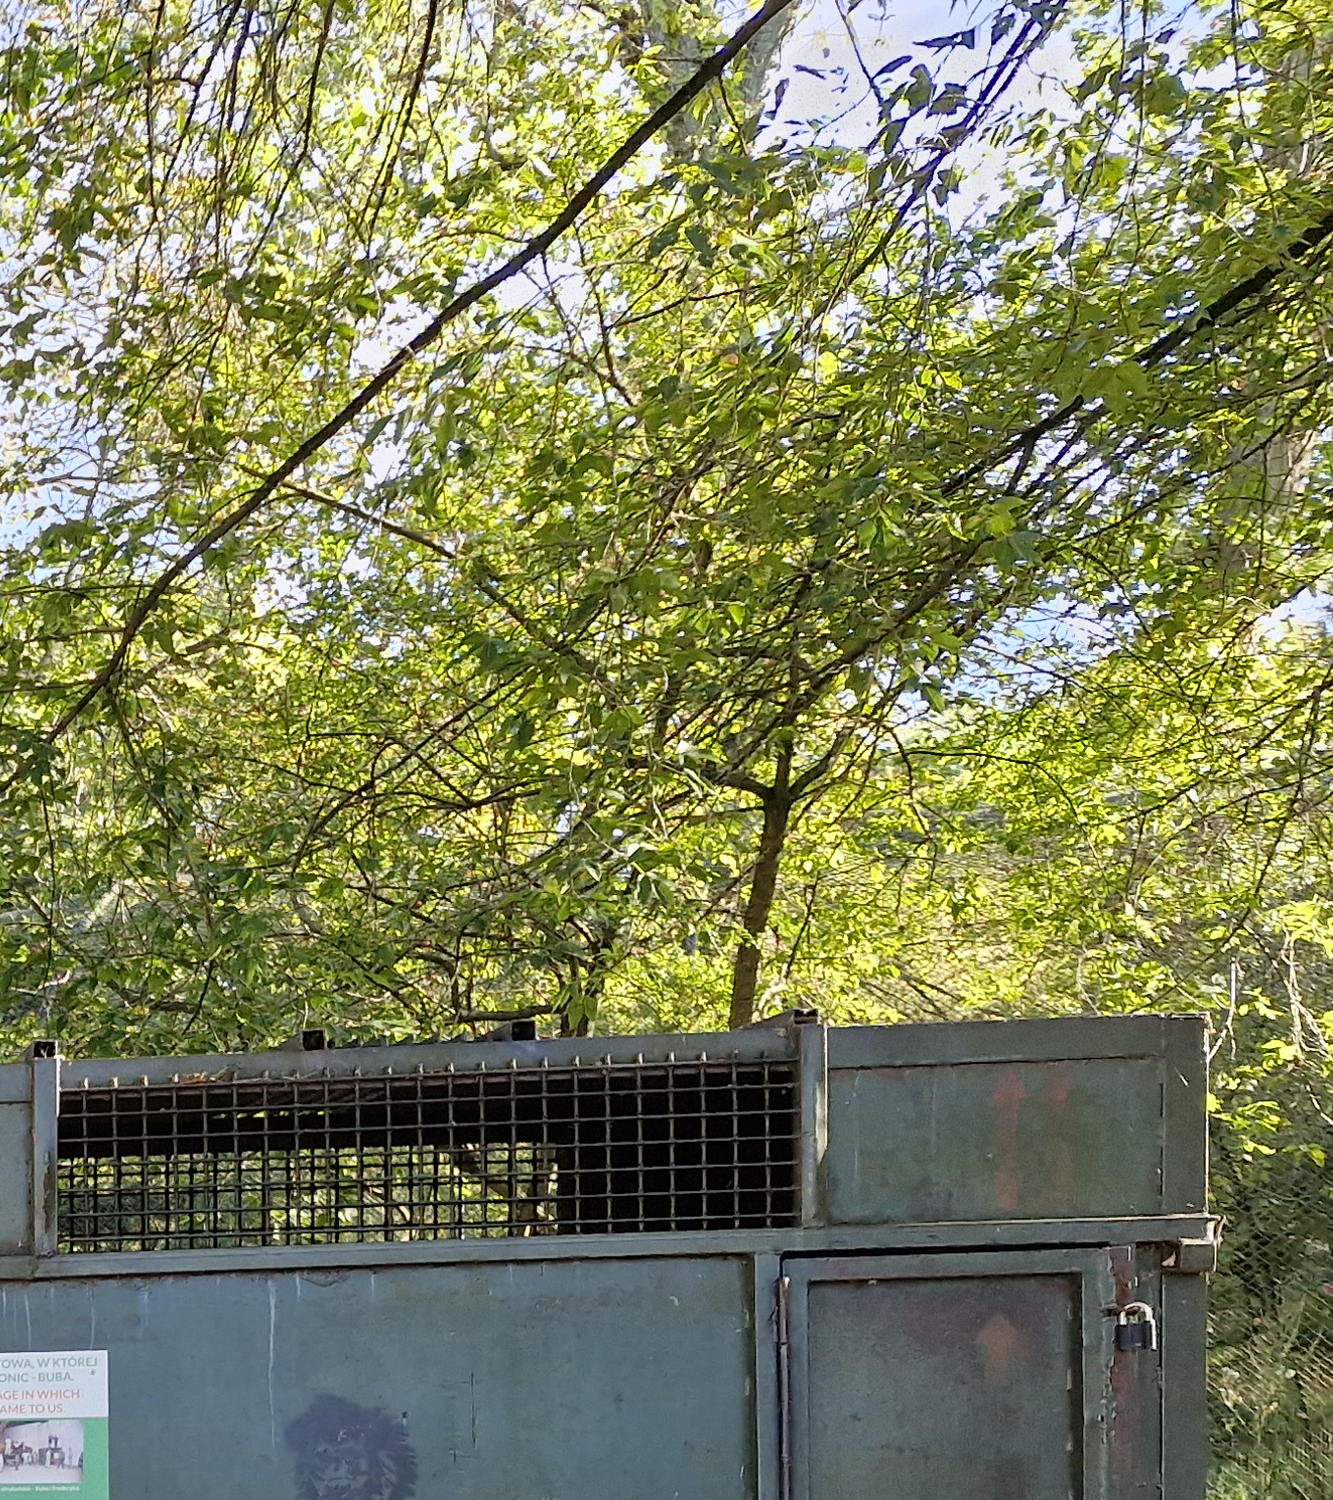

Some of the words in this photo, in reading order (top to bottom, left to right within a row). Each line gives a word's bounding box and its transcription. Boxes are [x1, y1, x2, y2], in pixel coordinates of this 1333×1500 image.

[36, 1358, 50, 1368] W
[52, 1355, 98, 1367] KTÓREJ
[38, 1371, 75, 1383] BUBA.
[21, 1390, 34, 1400] IN
[36, 1388, 81, 1400] WHICH
[28, 1403, 45, 1414] TO
[47, 1402, 66, 1414] US.
